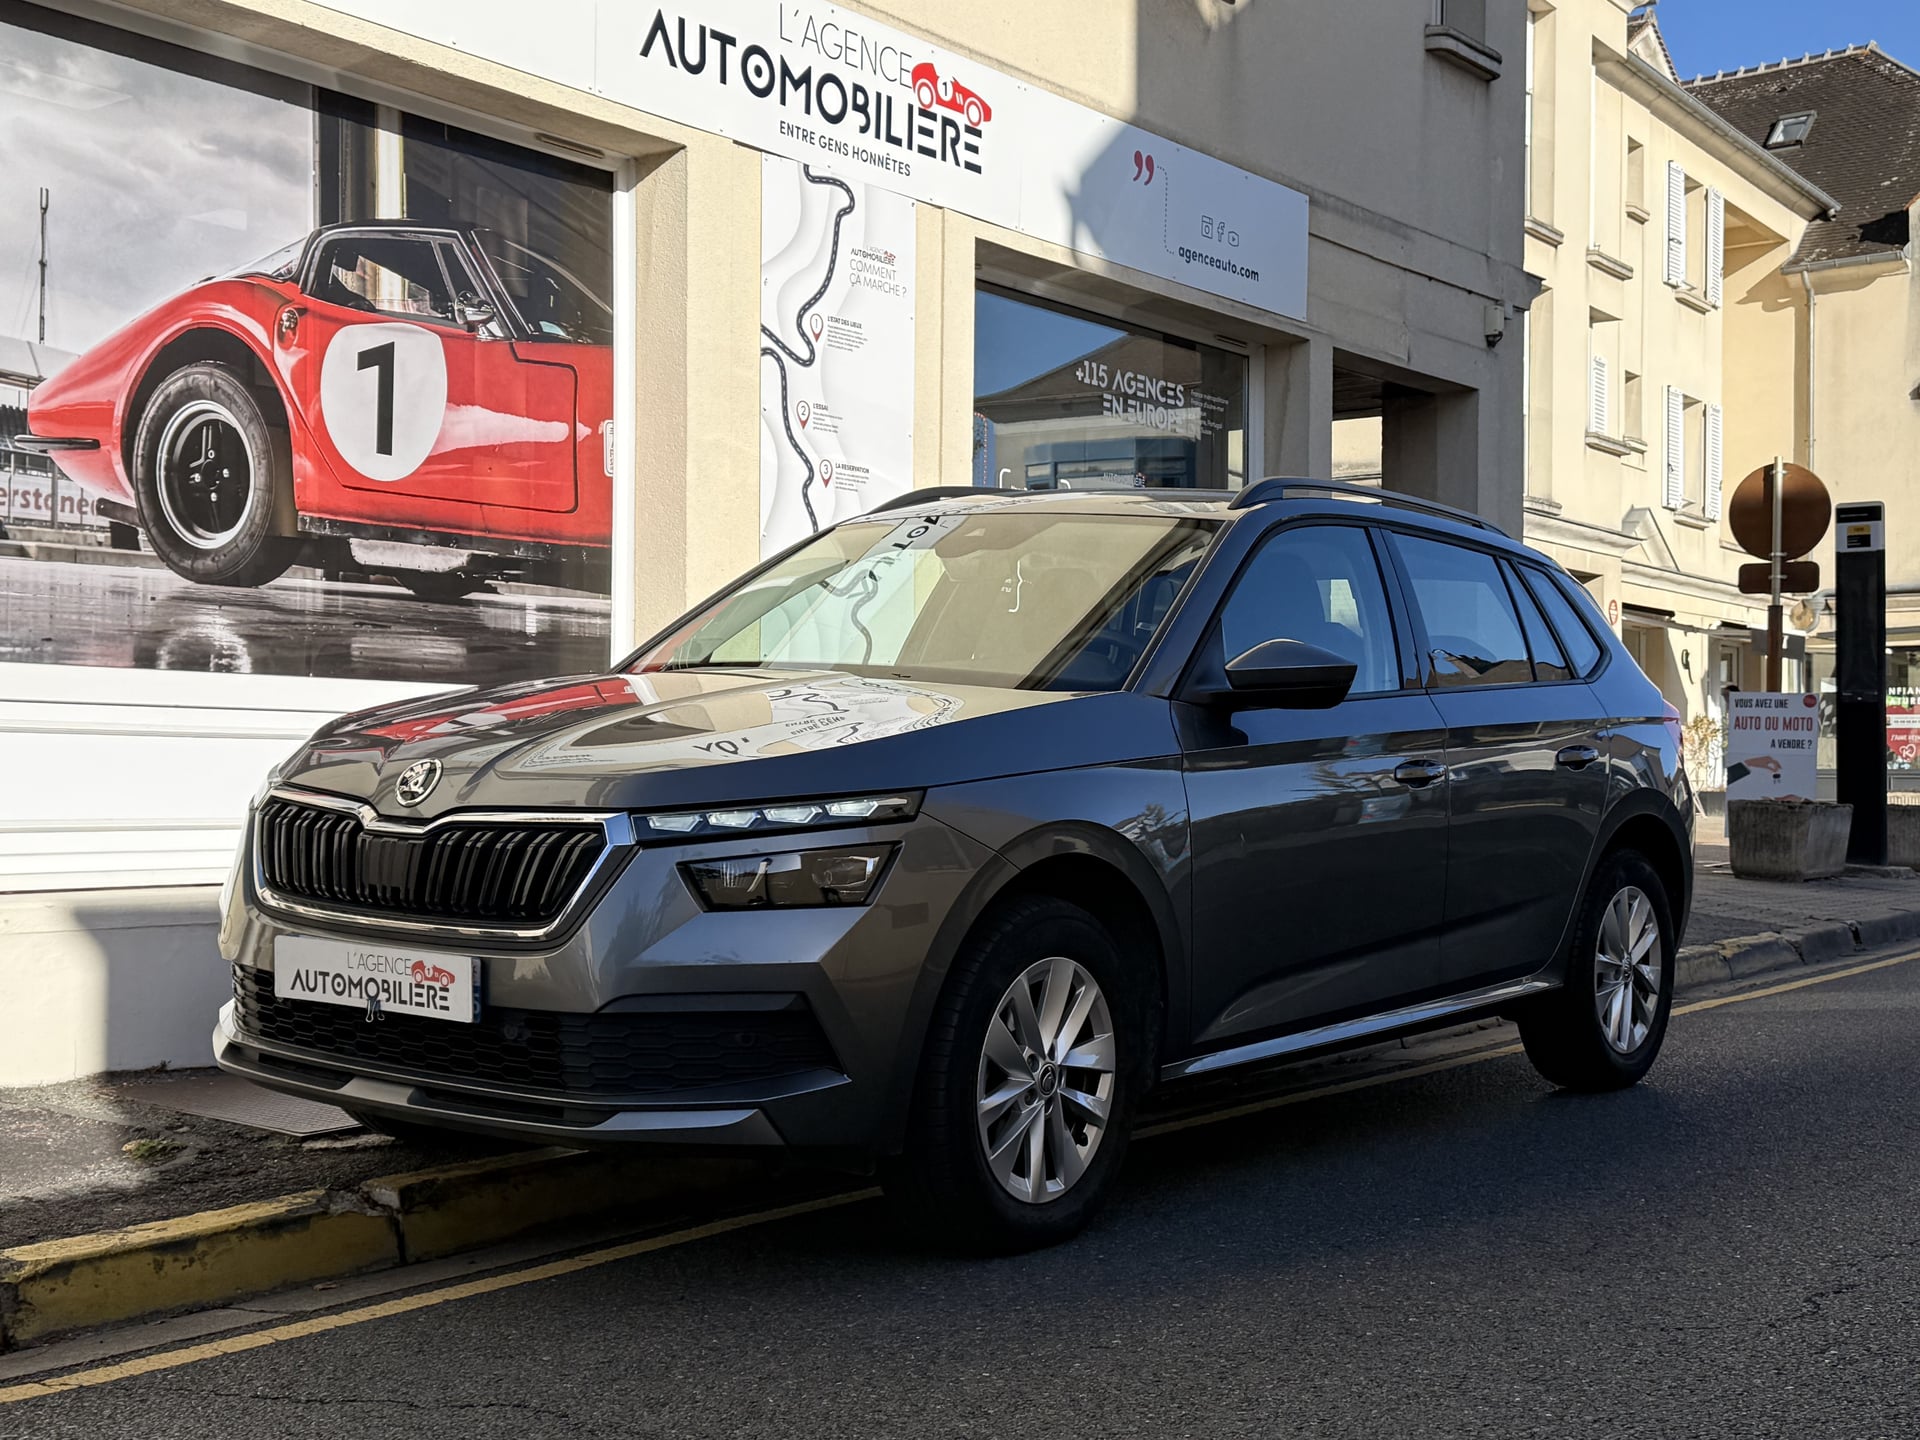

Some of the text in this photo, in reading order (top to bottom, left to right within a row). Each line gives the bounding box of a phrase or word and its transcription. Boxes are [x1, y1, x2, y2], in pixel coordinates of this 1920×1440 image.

[779, 3, 912, 89] L'AGENCE
[779, 120, 911, 177] ENTRE GENS HONNÊTES
[849, 258, 897, 281] COMMENT
[1178, 245, 1260, 282] agenceauto.com
[849, 272, 862, 287] ÇA
[863, 276, 900, 297] MARCHE
[1075, 359, 1185, 408] +115 AGENCES
[356, 341, 396, 457] 1
[1102, 393, 1124, 418] EN
[1735, 698, 1789, 709] VOUS AVEZ UNE
[1734, 716, 1813, 732] AUTO OU MOTO
[1770, 738, 1813, 750] A VENDRE ?
[346, 951, 412, 977] L'AGENCE
[290, 968, 450, 1012] AUTOMOBILIERE
